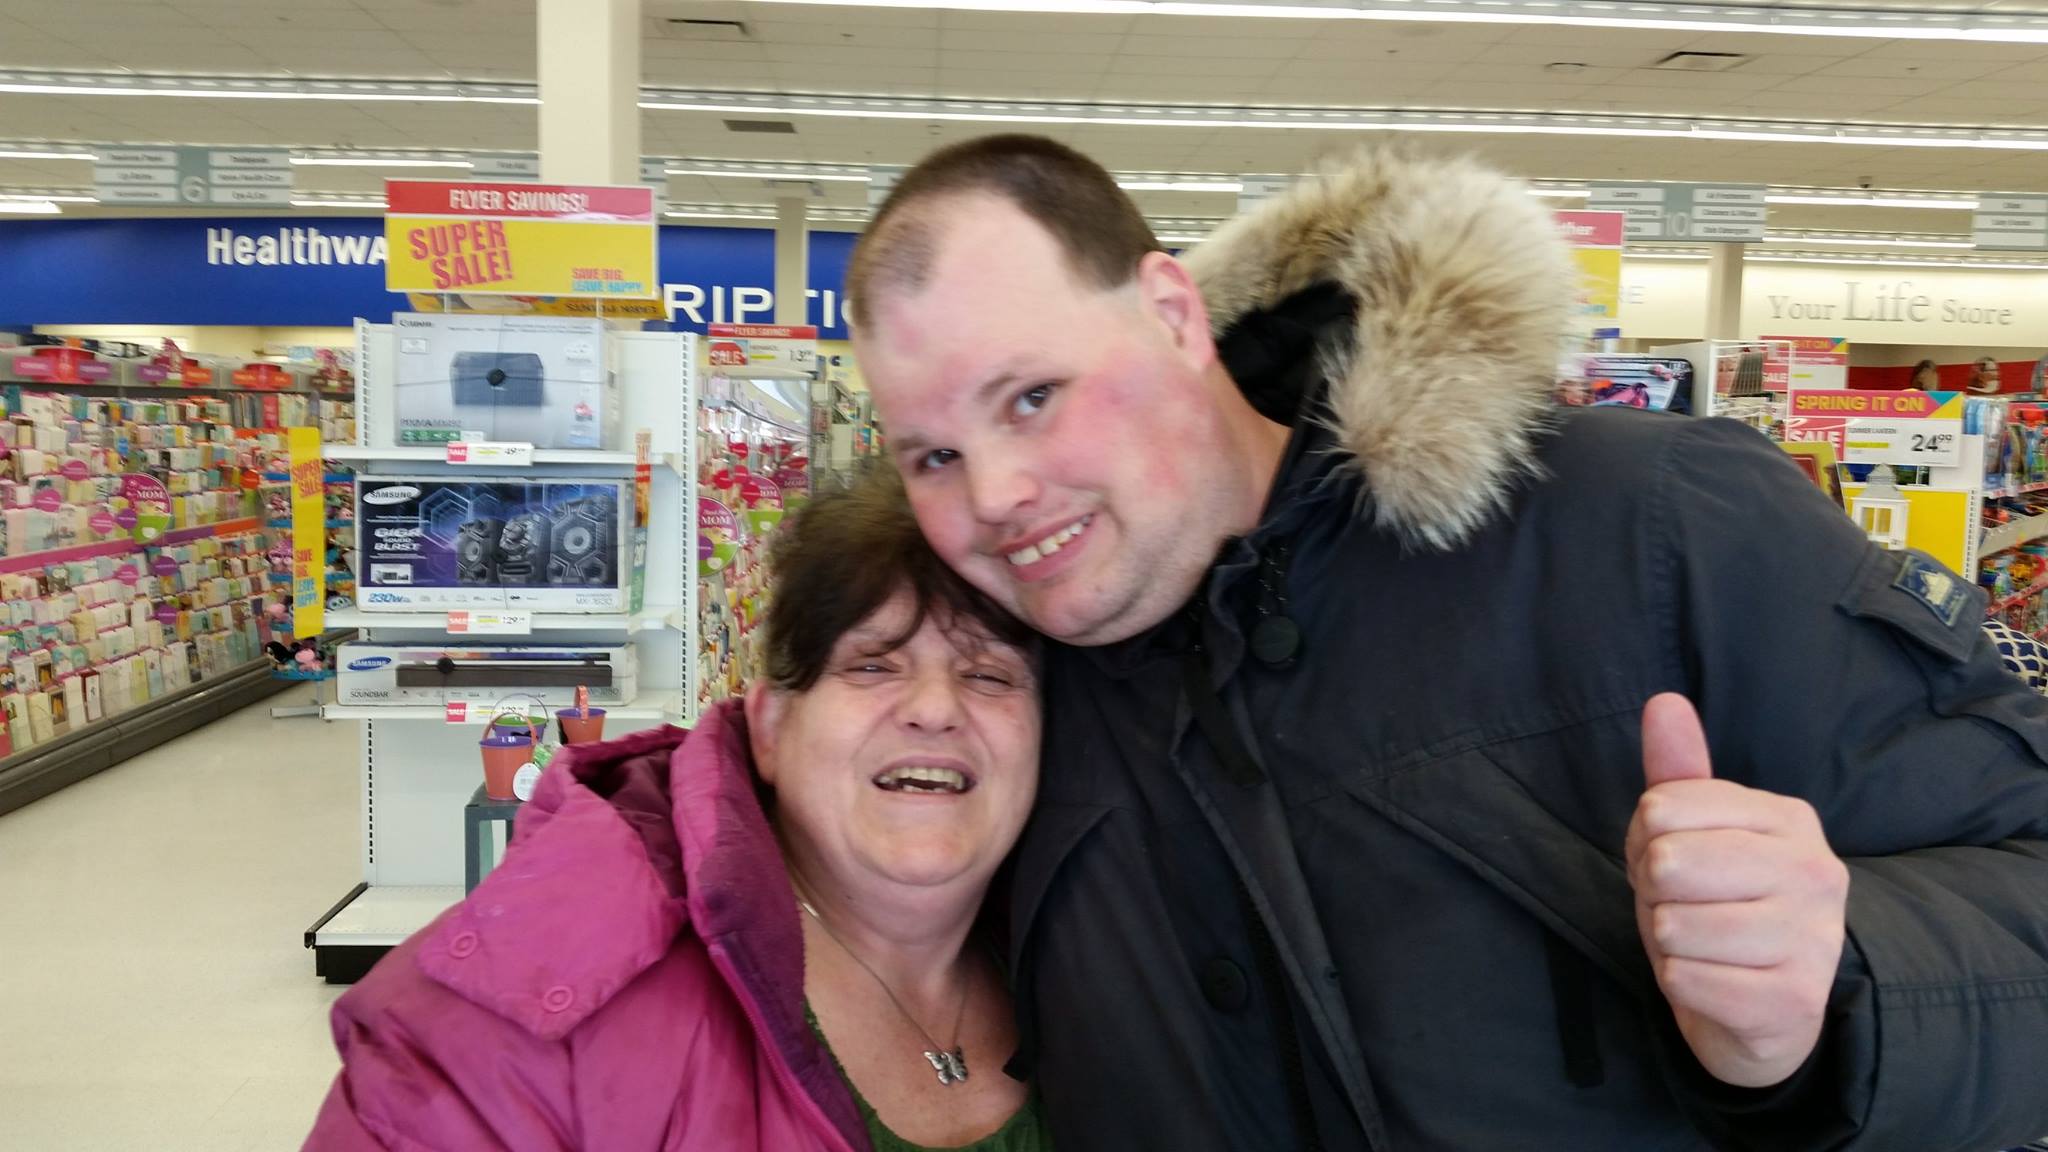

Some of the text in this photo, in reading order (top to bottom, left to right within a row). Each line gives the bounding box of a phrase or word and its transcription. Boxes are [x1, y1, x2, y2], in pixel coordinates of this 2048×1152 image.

[450, 189, 588, 212] FLYER SAVINGS!
[409, 220, 507, 260] SUPER
[431, 250, 513, 290] SALE!
[1767, 281, 2013, 325] Your Life Store
[710, 350, 748, 366] SALE
[1763, 372, 1788, 383] SALE
[1795, 394, 1926, 412] SPRING IT ON
[1788, 428, 1842, 449] SALE
[136, 489, 165, 499] MOM
[372, 489, 412, 499] SAMSUNG
[701, 515, 730, 525] MOM
[351, 659, 387, 668] SAMSUNG
[350, 690, 390, 698] SOUNDBAR
